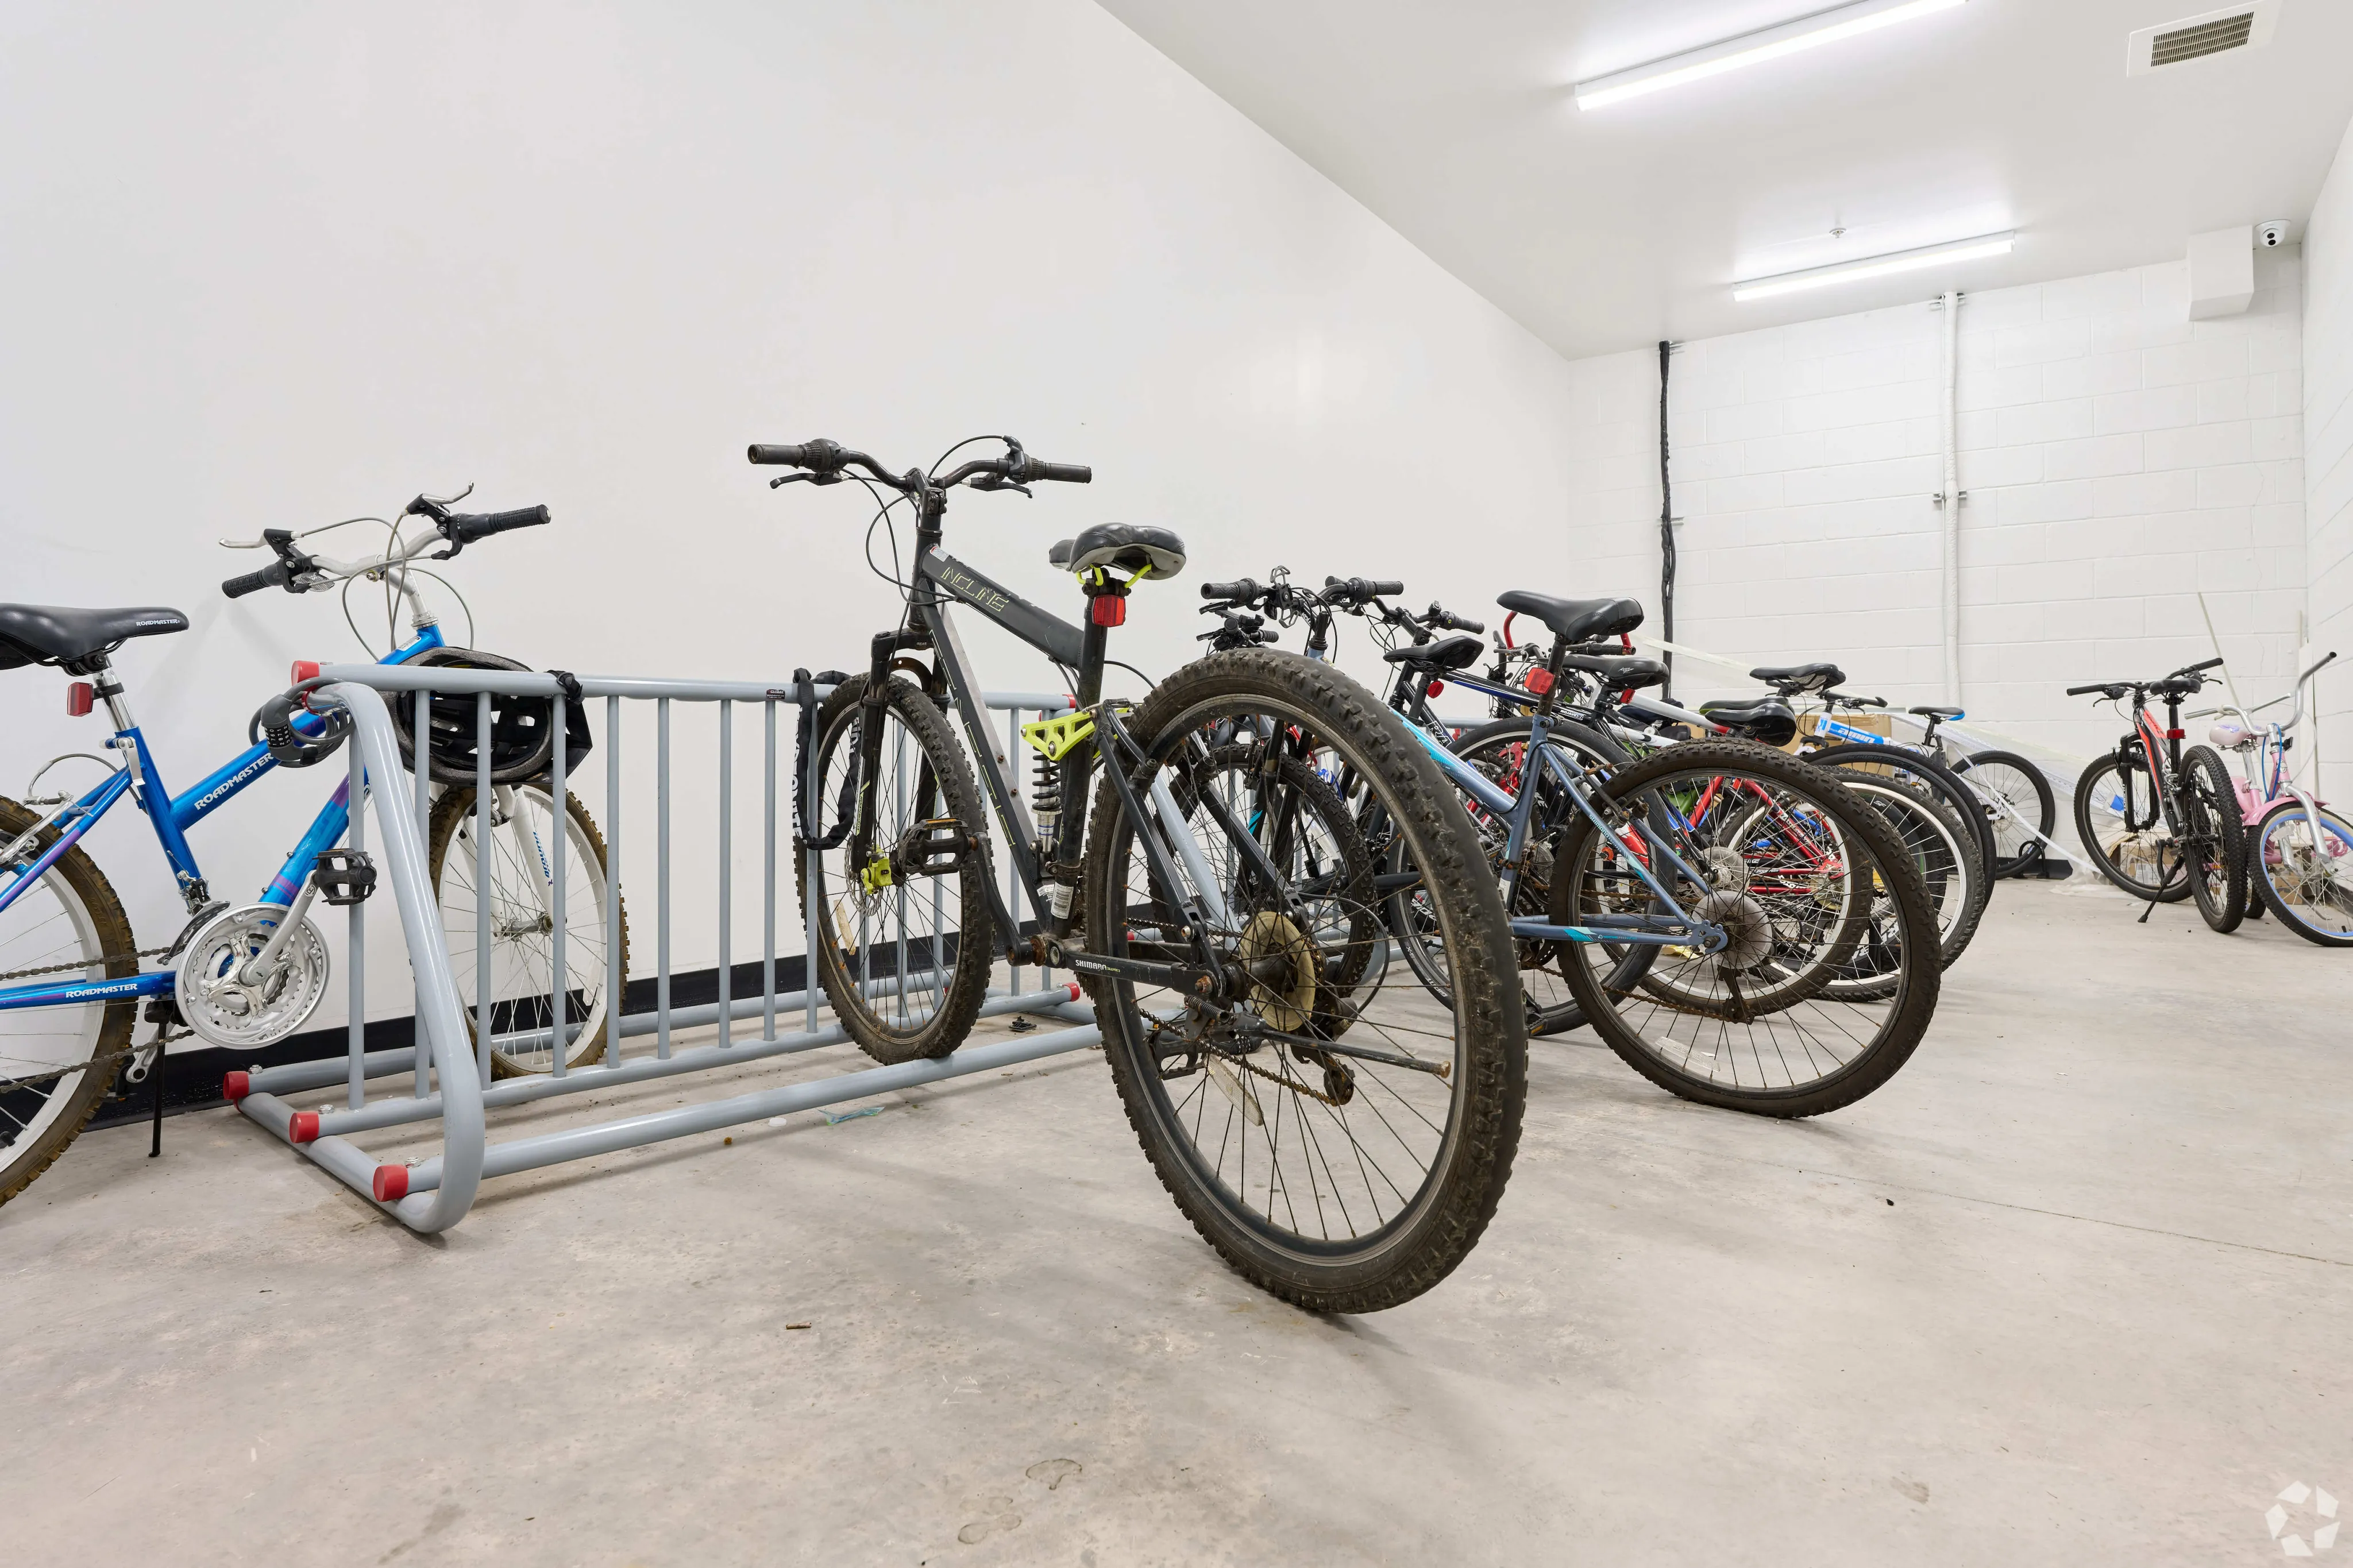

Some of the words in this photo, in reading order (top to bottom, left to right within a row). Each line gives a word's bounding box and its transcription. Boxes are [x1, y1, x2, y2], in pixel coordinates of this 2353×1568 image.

[940, 566, 1010, 612] INCLINE
[194, 752, 274, 810] ROADMASTER
[1589, 814, 1610, 839] SHIMANO
[65, 983, 138, 998] ROADMASTER
